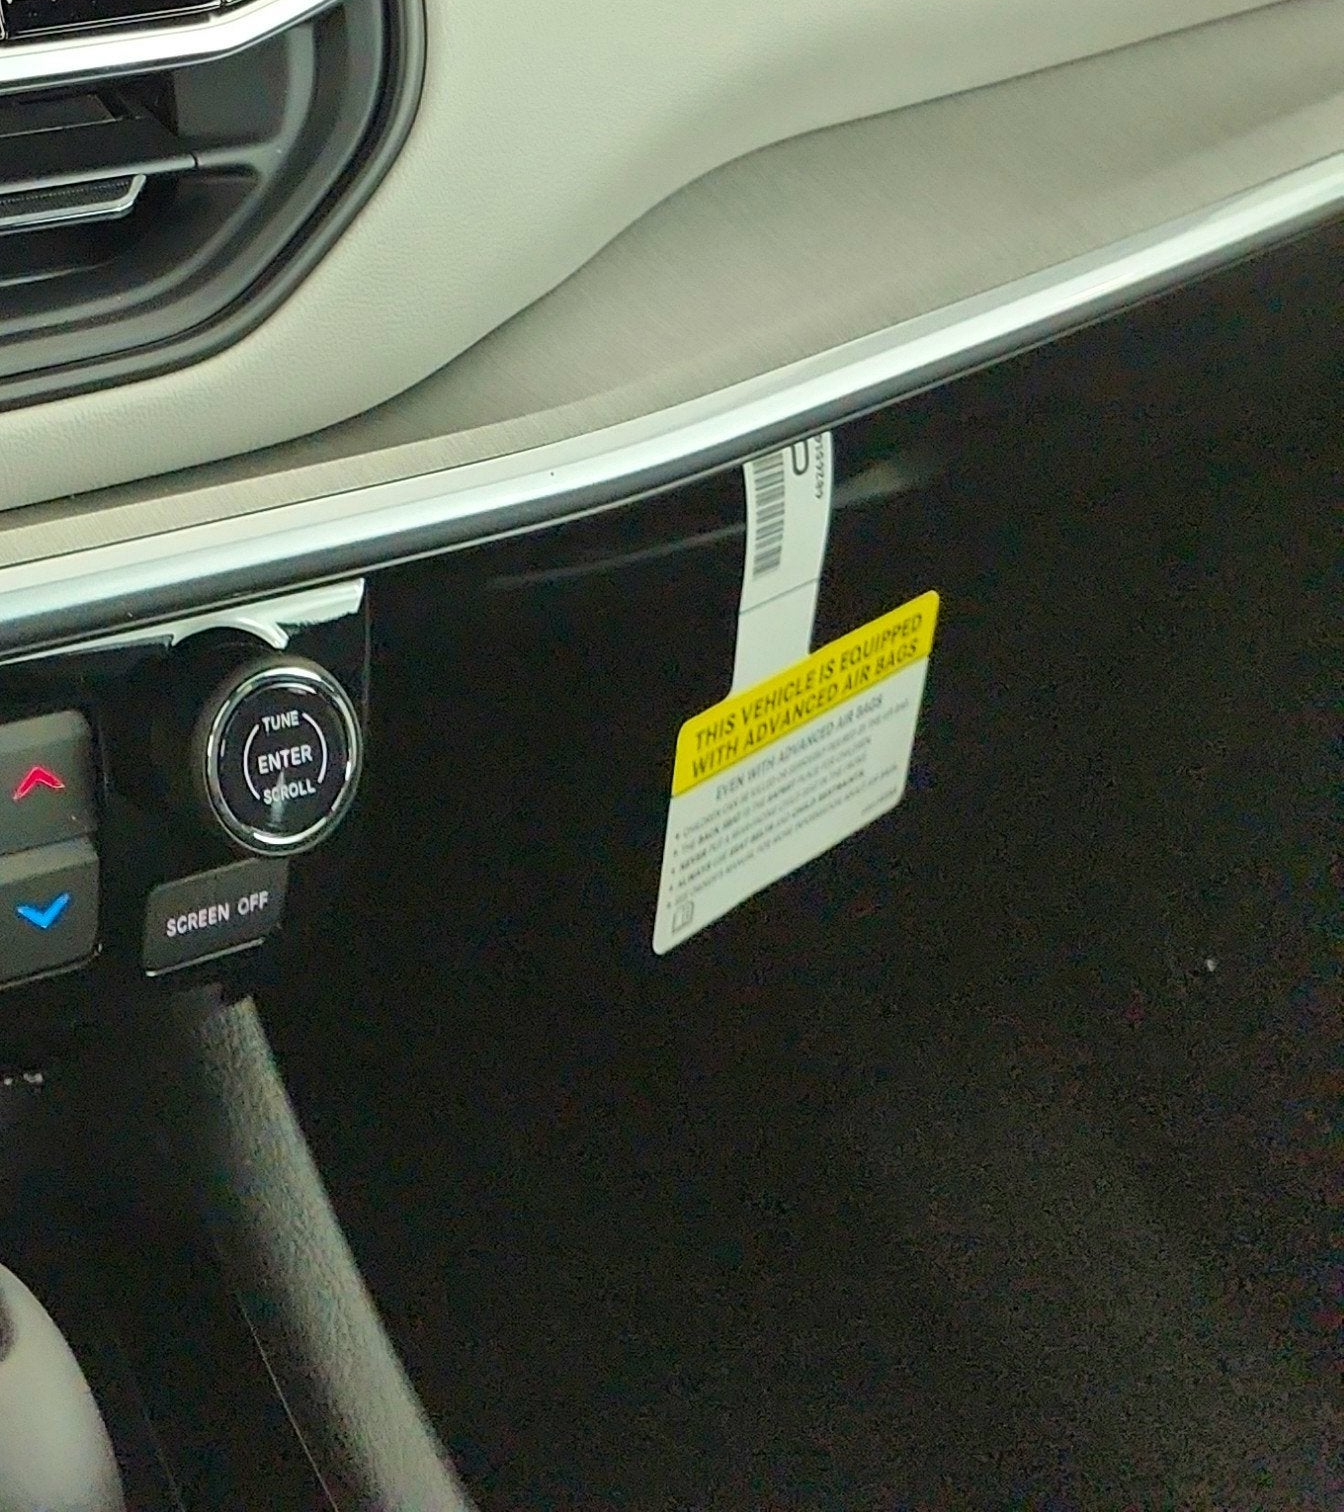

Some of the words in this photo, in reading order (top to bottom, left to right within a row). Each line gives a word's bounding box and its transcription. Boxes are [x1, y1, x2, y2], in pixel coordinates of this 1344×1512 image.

[694, 712, 735, 751] THIS
[741, 670, 814, 725] VEHICLE
[819, 659, 834, 682] IS
[840, 612, 923, 670] EQUIPPED
[262, 709, 299, 734] TUNE
[691, 736, 738, 778] WITH
[744, 681, 838, 748] ADVANCED
[844, 663, 870, 692] AIR
[875, 637, 918, 674] BAGS
[837, 710, 854, 729] AIR
[257, 744, 313, 775] ENTER
[263, 778, 316, 805] SCROLL
[166, 902, 230, 938] SCREEN
[237, 890, 269, 916] OFF
